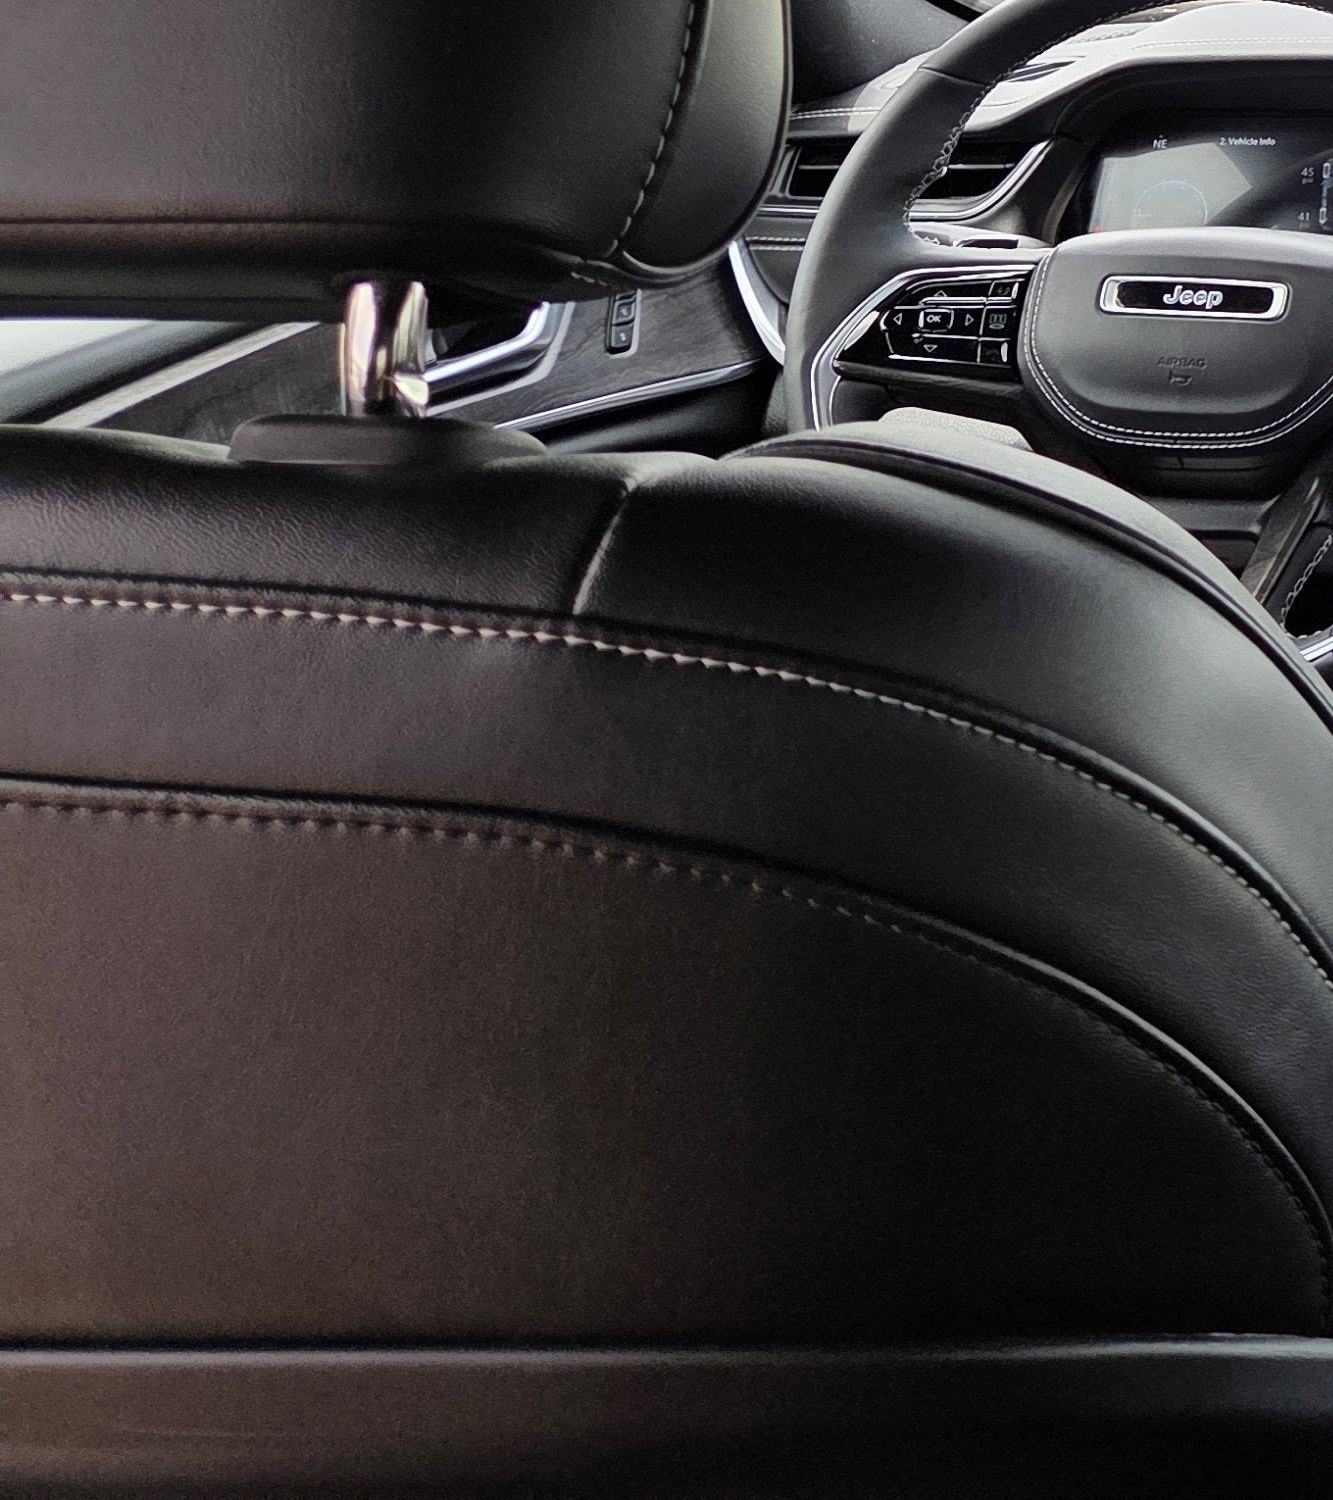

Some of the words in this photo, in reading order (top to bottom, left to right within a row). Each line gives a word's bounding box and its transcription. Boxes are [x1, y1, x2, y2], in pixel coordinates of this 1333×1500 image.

[1152, 139, 1168, 149] NE
[1228, 137, 1258, 146] Vehicle
[1259, 137, 1277, 146] Info
[1301, 167, 1315, 177] 45
[1298, 212, 1310, 221] 41
[1162, 285, 1224, 310] Jeep
[926, 314, 942, 323] OK
[1157, 356, 1208, 369] AIRBAG
